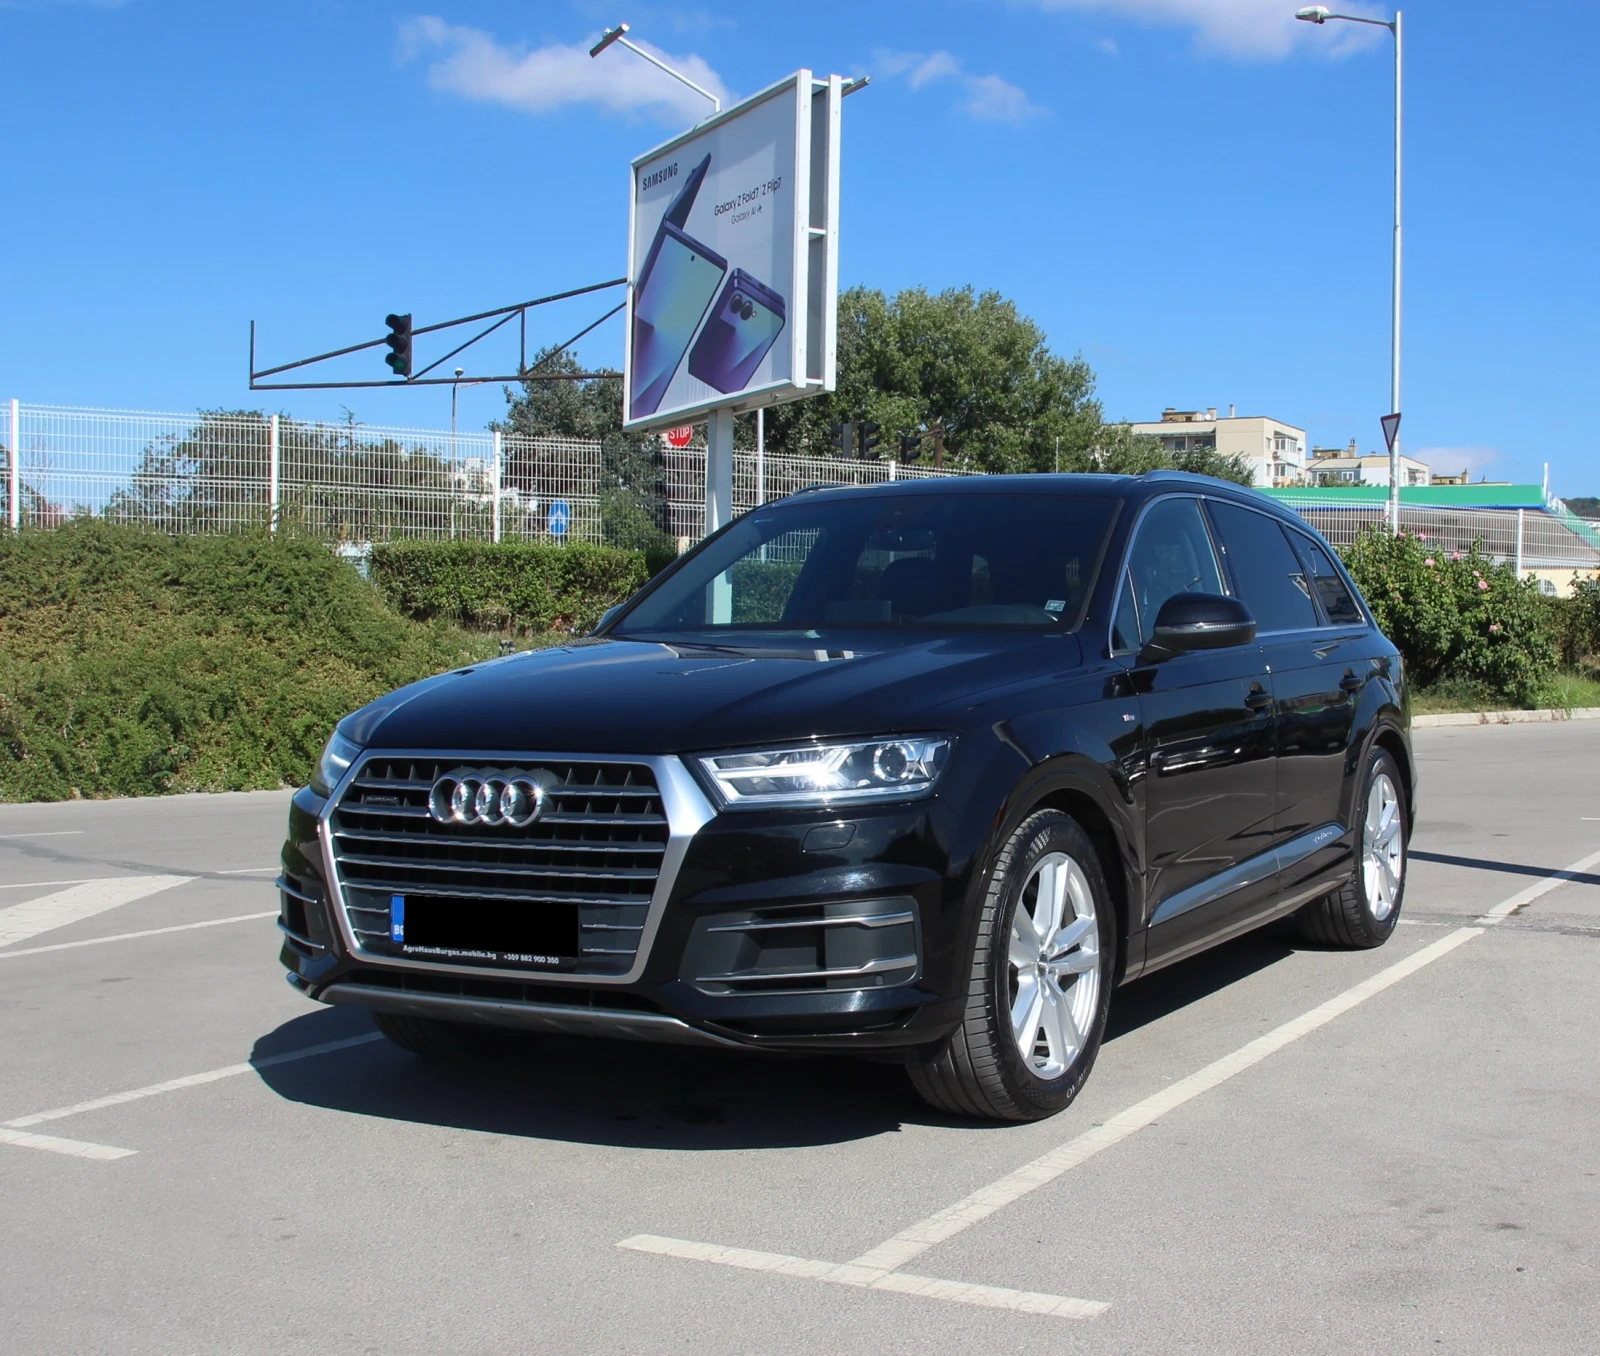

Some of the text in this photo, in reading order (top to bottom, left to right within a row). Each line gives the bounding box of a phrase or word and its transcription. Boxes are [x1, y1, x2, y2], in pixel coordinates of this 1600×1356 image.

[642, 162, 678, 191] SAMSUNG
[714, 177, 782, 216] Galaxy Z Fold7 Z Flip7
[731, 210, 750, 225] Galaxy
[669, 426, 690, 440] STOP
[403, 944, 560, 964] AgroHausBurgas.mobile.bg +359 882 900 350
